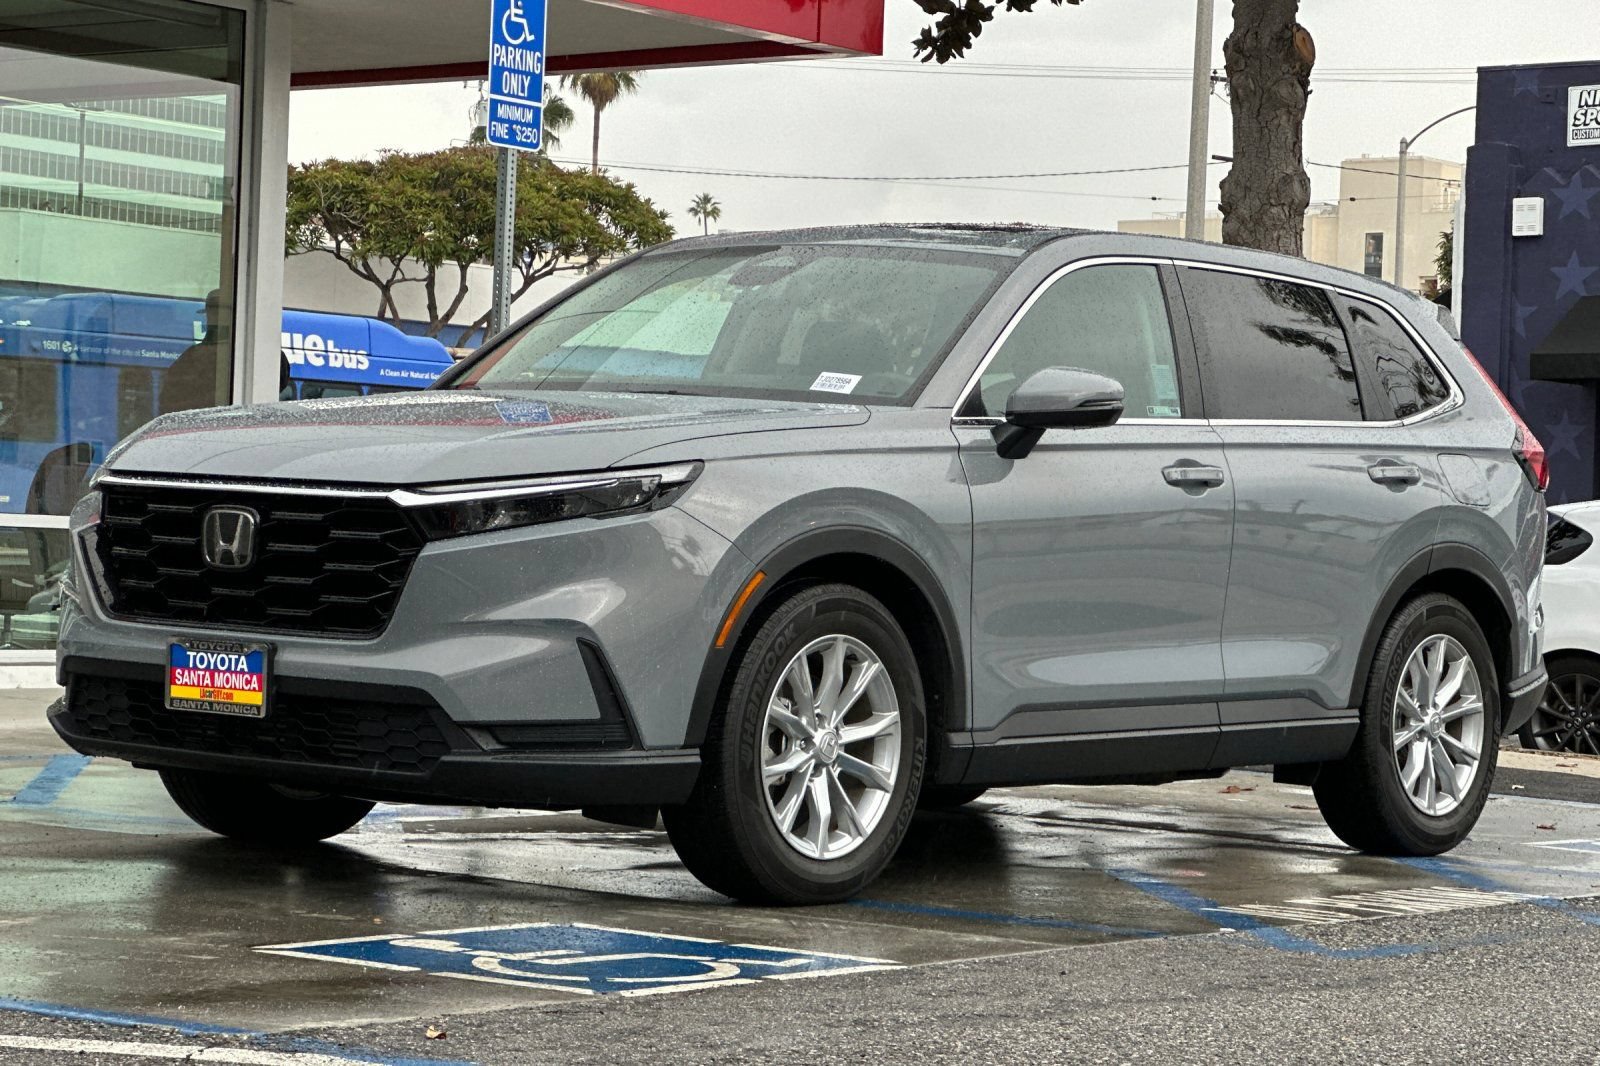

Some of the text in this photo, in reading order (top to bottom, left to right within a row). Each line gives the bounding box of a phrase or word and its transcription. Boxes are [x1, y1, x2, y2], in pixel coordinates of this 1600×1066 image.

[494, 44, 541, 74] PARKING
[502, 71, 530, 97] ONLY
[497, 103, 533, 123] MINIMUM
[1572, 107, 1600, 127] SP
[491, 122, 537, 144] FINE $250
[42, 340, 60, 350] 1601
[327, 340, 370, 370] bus
[385, 369, 400, 377] Clean
[410, 371, 430, 379] Natural
[192, 640, 241, 652] TOYOTA
[186, 652, 248, 672] TOYOTA
[176, 669, 258, 690] SANTA MONICA
[172, 699, 258, 715] SANTA MONICA
